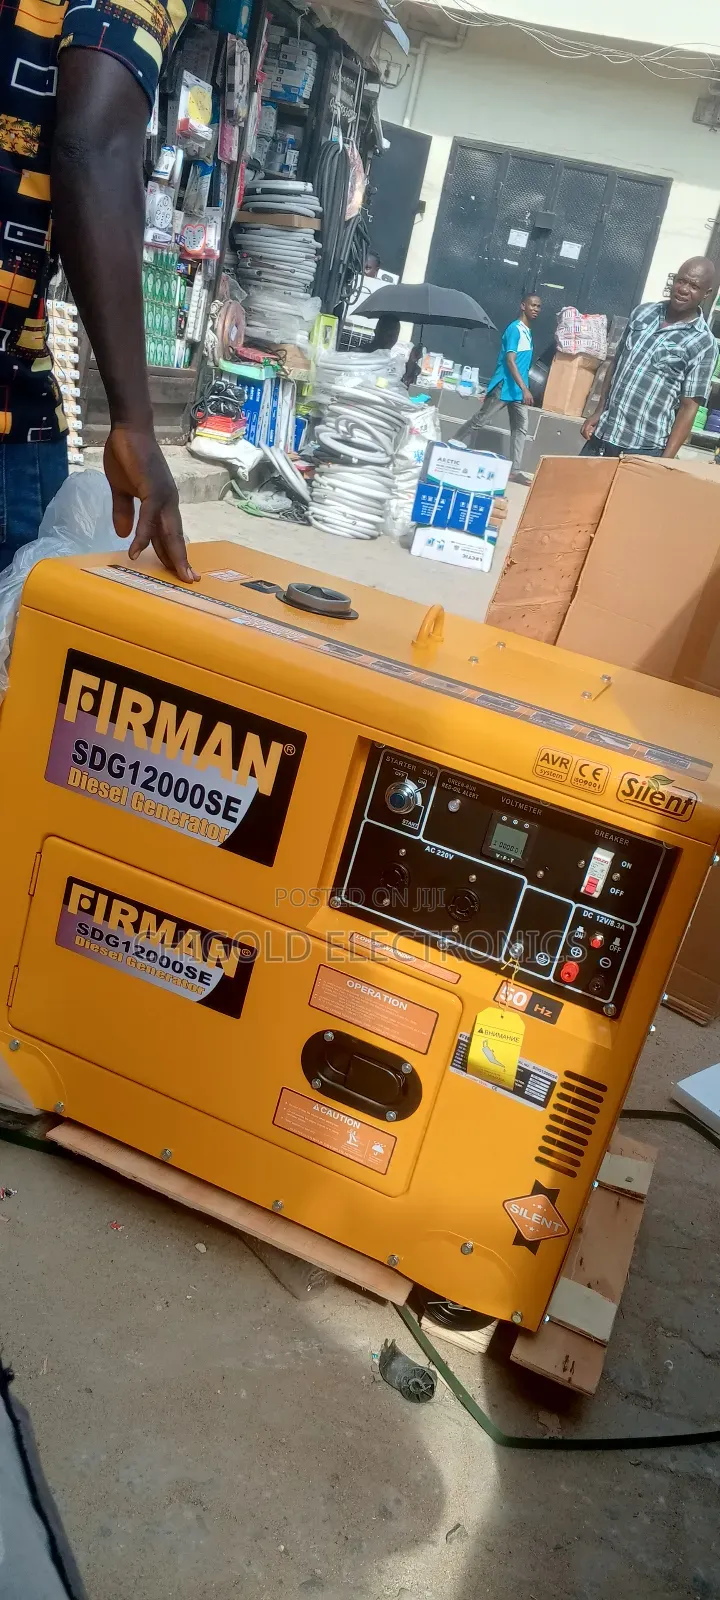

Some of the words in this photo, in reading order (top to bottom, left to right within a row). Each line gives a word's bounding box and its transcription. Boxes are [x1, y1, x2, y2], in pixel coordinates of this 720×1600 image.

[437, 457, 460, 465] ARCTIC
[63, 668, 284, 797] FIRMAN
[385, 755, 417, 772] STARTER
[422, 768, 435, 778] SW.
[540, 752, 570, 770] AVR
[71, 738, 243, 824] SDG12000SE
[394, 770, 405, 778] OFF
[539, 768, 563, 780] system
[441, 782, 461, 794] RED-OIL
[462, 790, 479, 800] ALERT
[447, 777, 477, 792] GREEN-RUN
[574, 777, 601, 790] ISO9001
[66, 765, 130, 807] Diesel
[130, 789, 231, 844] Generator
[621, 777, 694, 816] Silent
[500, 796, 543, 816] VOLTMETER
[402, 818, 418, 828] START
[594, 829, 630, 847] BREAKER
[424, 845, 437, 855] AC
[437, 848, 455, 860] 220V
[621, 860, 633, 870] ON
[609, 887, 625, 897] OFF
[582, 909, 594, 919] DC
[595, 915, 626, 931] 12V/8.3A
[67, 882, 241, 979] FIRMAN
[574, 931, 585, 940] ON
[76, 921, 213, 987] SDG12000SE
[609, 944, 622, 953] OFF
[74, 934, 125, 964] Diesel
[125, 955, 206, 996] Generator
[346, 979, 408, 1011] OPERATION
[499, 985, 528, 1007] 50
[533, 1003, 553, 1018] Hz
[484, 1029, 520, 1043] ВНИМАНИЕ
[320, 1106, 361, 1129] CAUTION
[509, 1203, 563, 1233] SILENT
